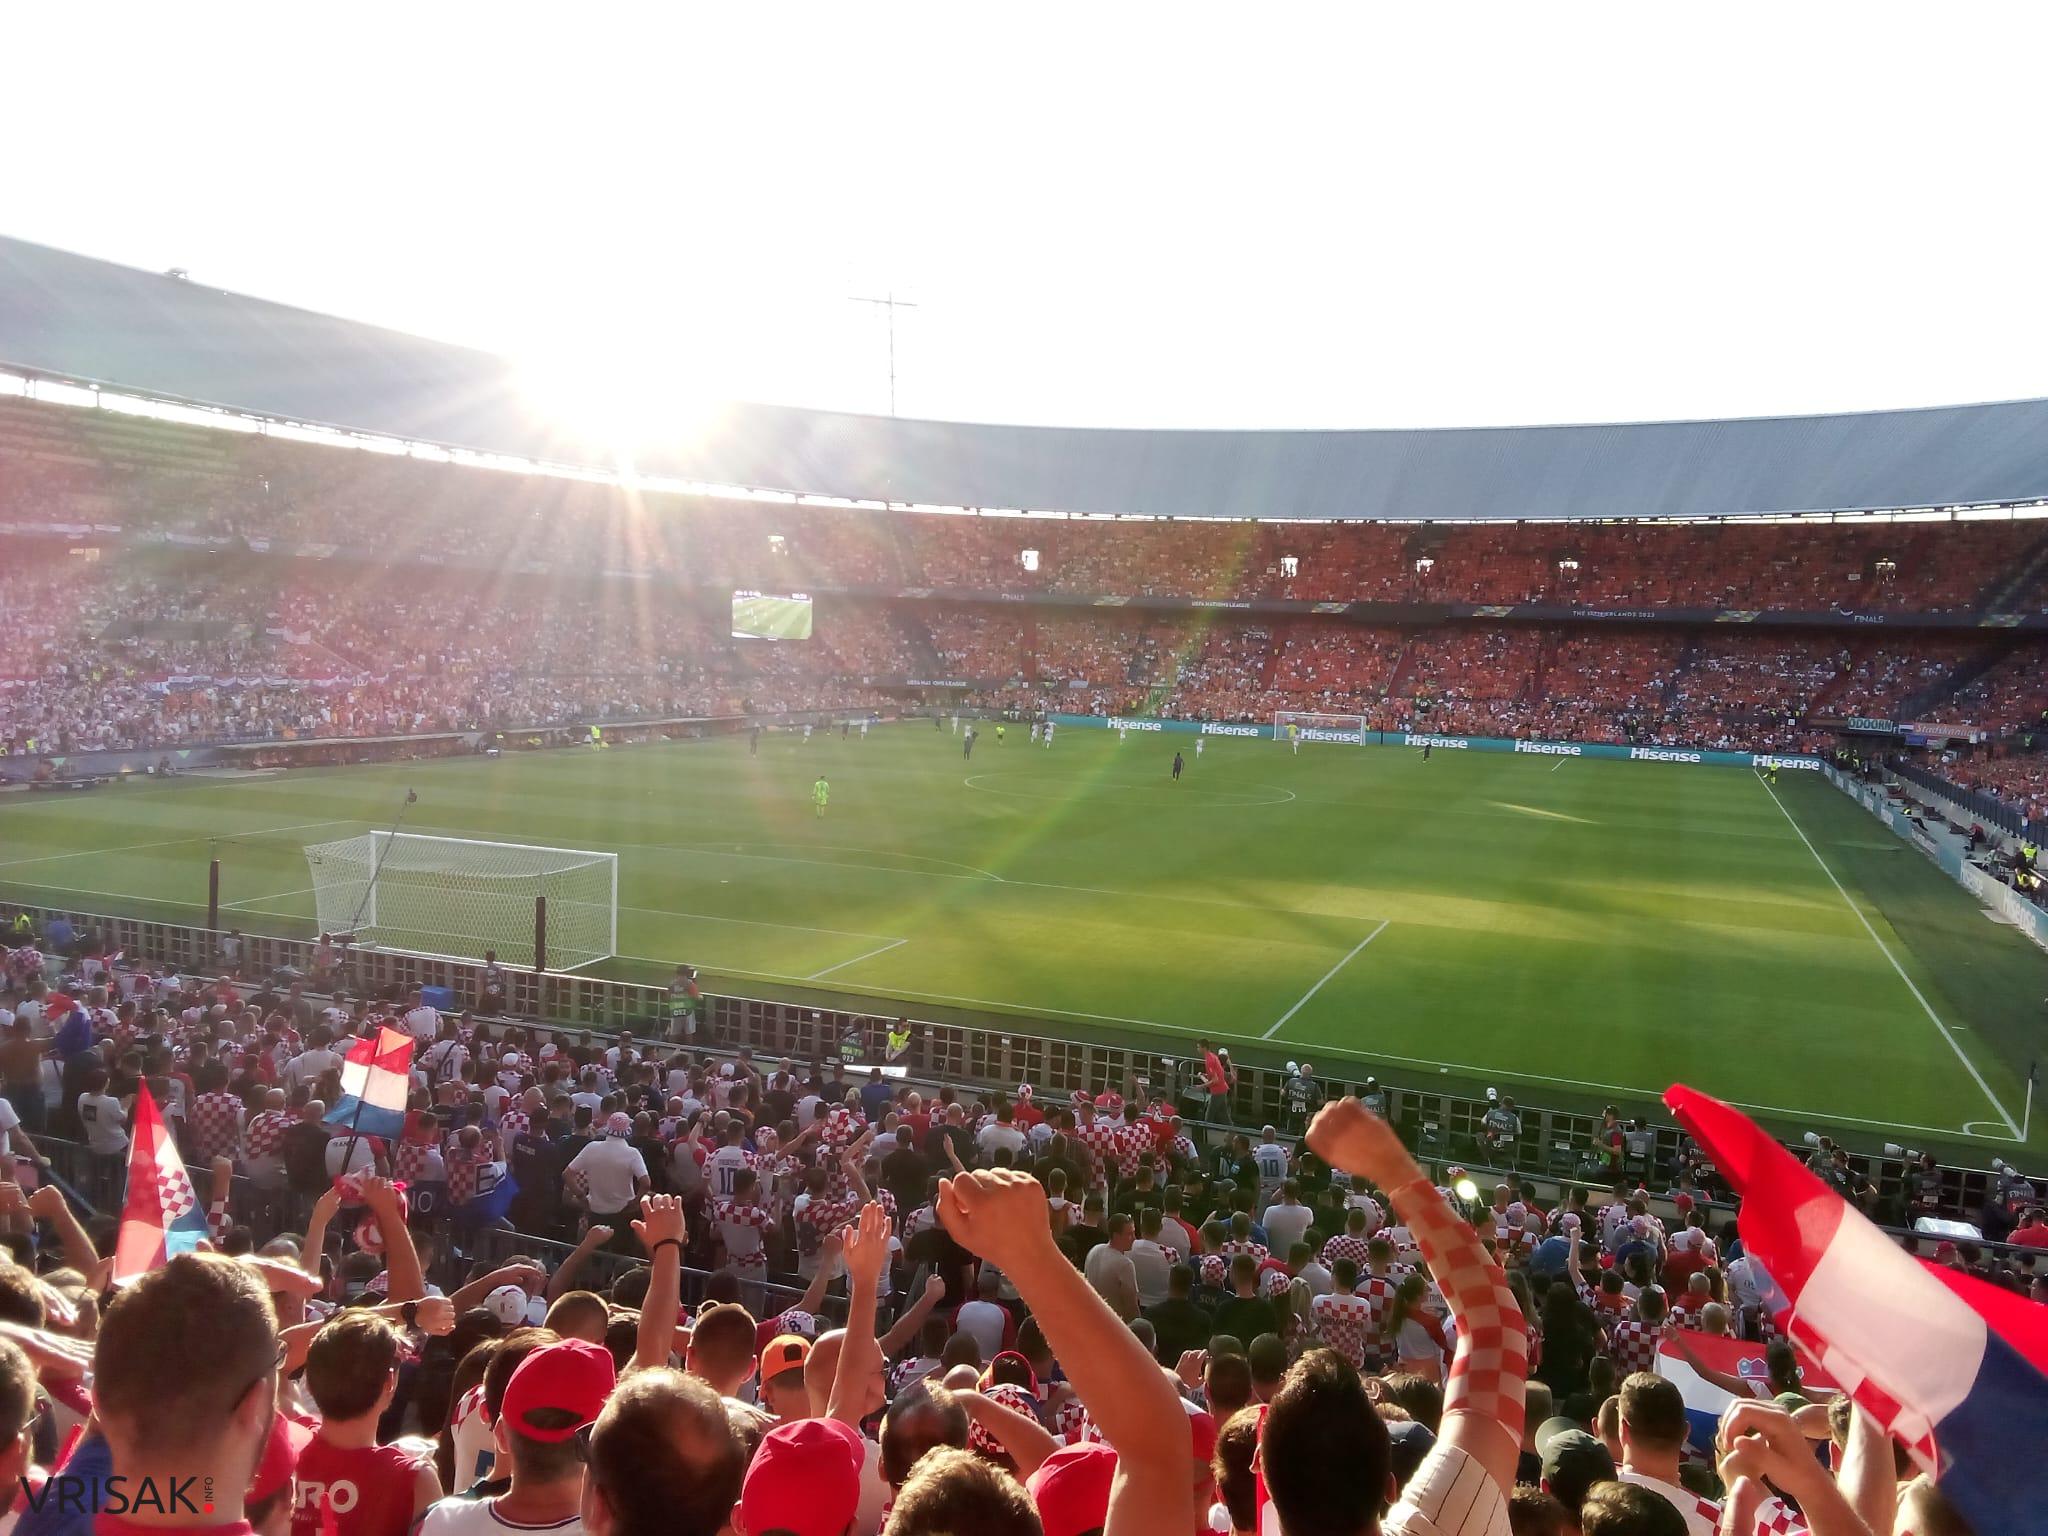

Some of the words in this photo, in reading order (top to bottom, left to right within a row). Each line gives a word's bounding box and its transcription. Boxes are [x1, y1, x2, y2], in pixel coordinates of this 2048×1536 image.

[1854, 615, 1885, 623] FINALS
[1107, 718, 1162, 731] Hisense
[1201, 723, 1259, 737] Hisense
[1849, 718, 1891, 731] ODOORN
[1300, 729, 1361, 743] Hisense
[1405, 734, 1468, 749] Hisense
[1515, 740, 1582, 756] Hisense
[1630, 747, 1701, 763] Hisense
[1752, 754, 1820, 771] Hisense
[1262, 1159, 1280, 1178] 10
[789, 1320, 802, 1333] 8
